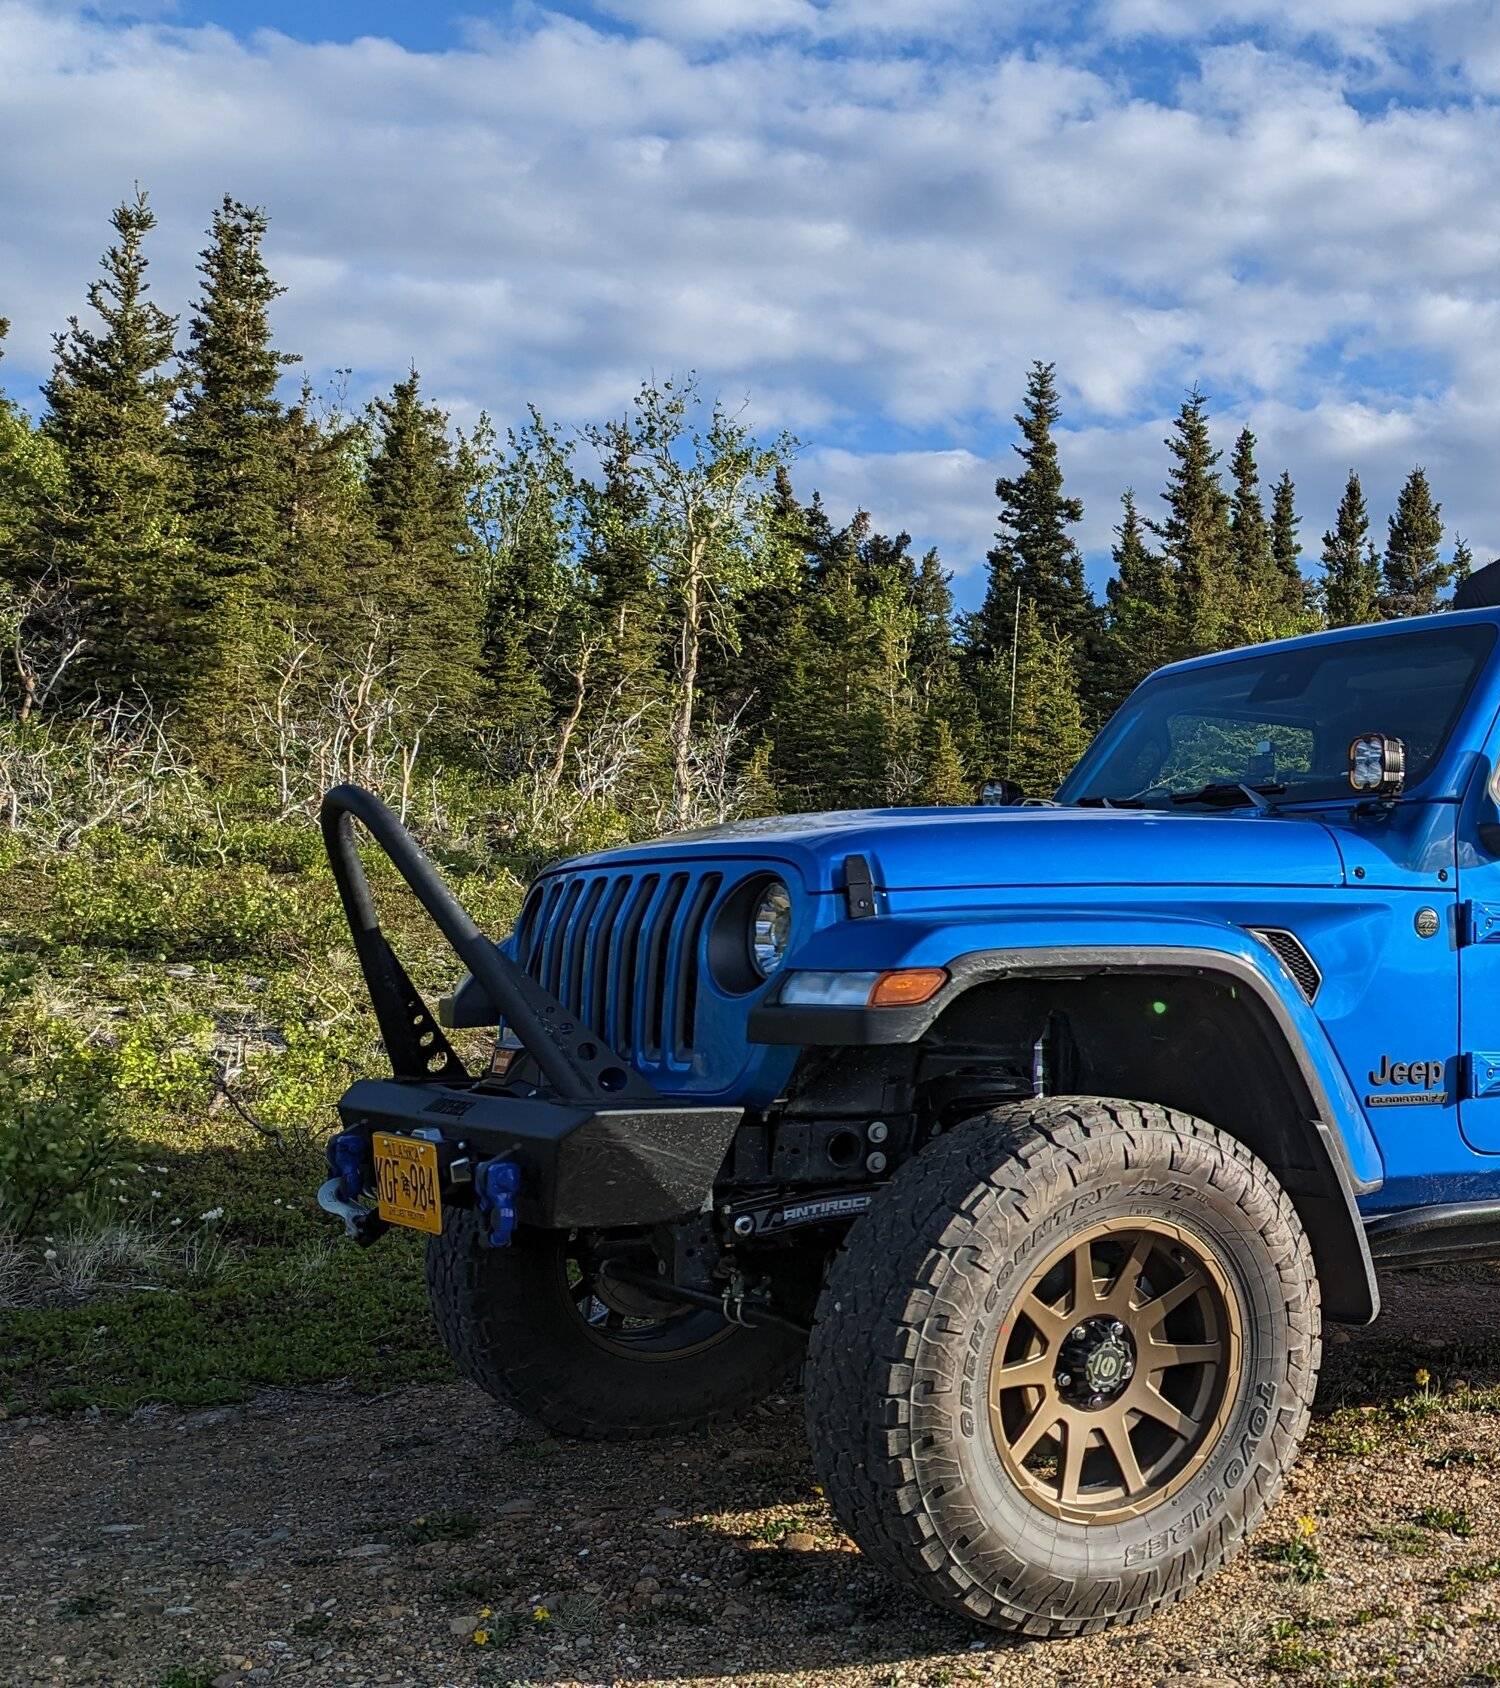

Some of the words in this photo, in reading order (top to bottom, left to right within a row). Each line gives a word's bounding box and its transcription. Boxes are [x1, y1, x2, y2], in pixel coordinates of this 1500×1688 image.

[1368, 1055, 1444, 1090] Jeep
[376, 1156, 400, 1204] KGF
[410, 1163, 436, 1215] 984
[961, 1319, 987, 1438] OPEN
[984, 1182, 1120, 1314] COUNTRY
[1126, 1178, 1198, 1201] A/T
[1223, 1381, 1278, 1489] TOYO
[1124, 1486, 1226, 1567] TIRES
